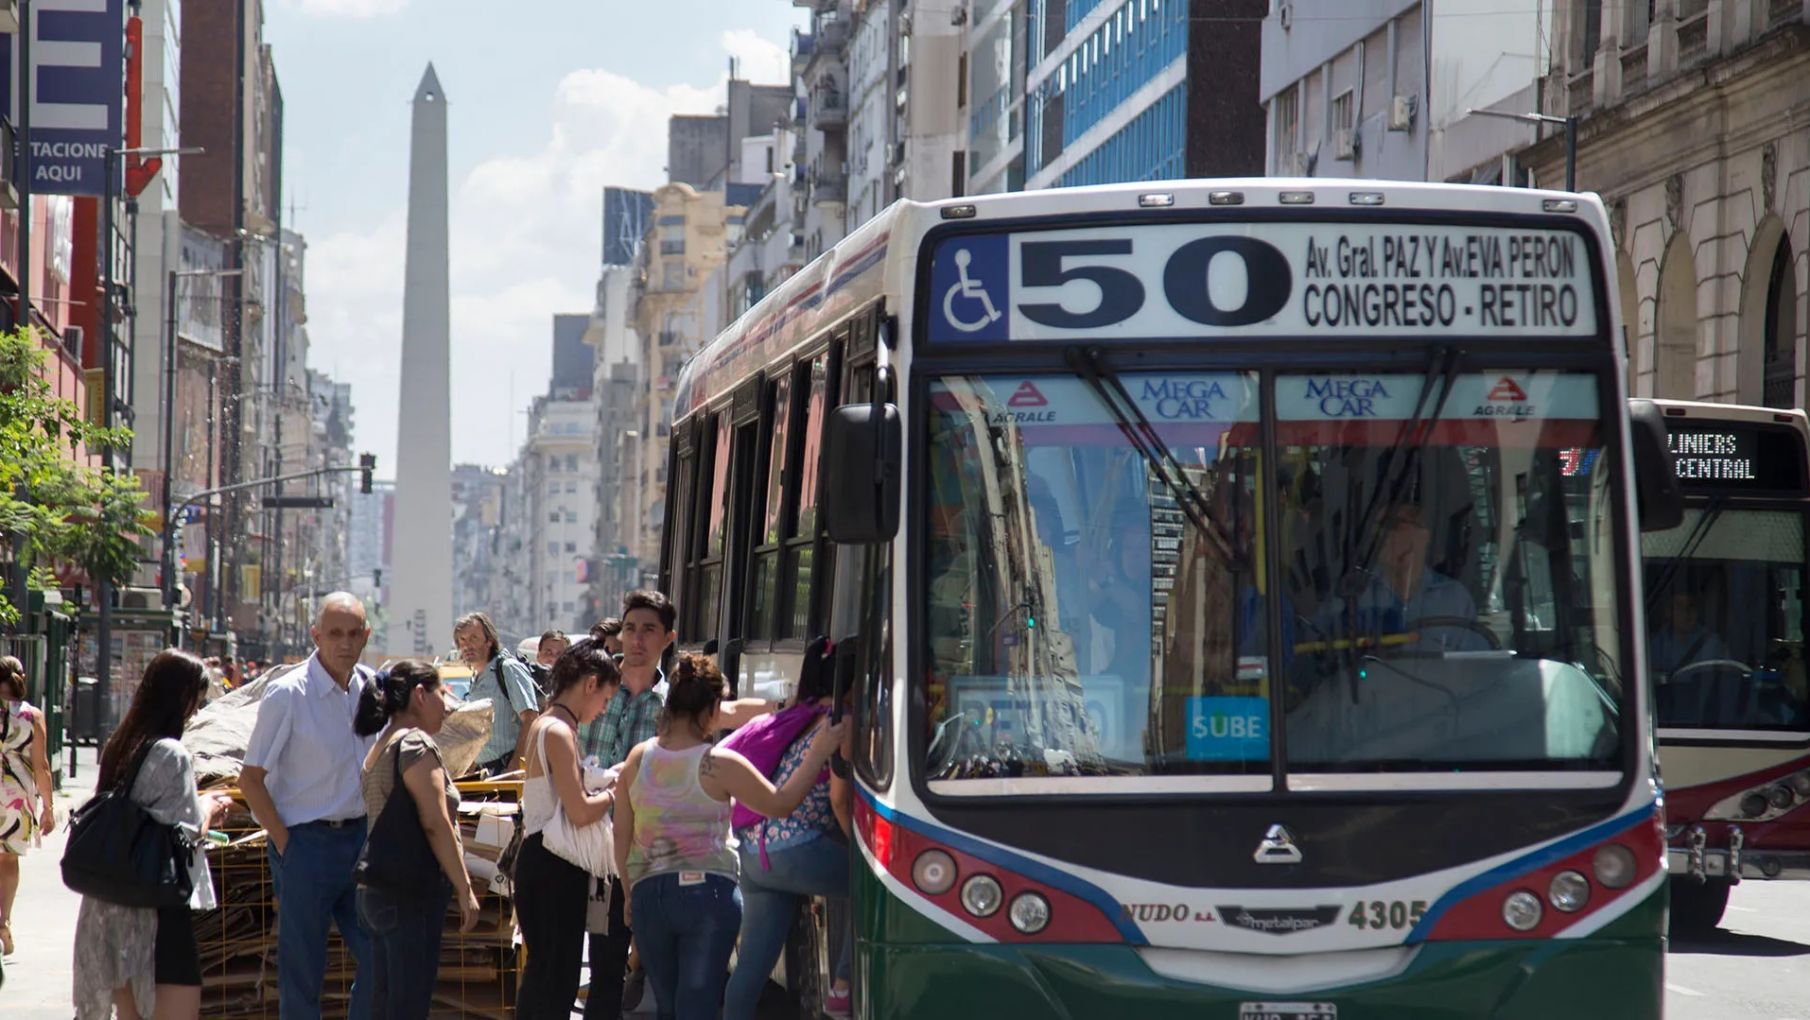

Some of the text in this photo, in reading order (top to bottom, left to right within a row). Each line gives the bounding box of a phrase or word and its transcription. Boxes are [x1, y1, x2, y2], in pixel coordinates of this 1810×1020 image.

[36, 165, 81, 182] AQUI
[1305, 235, 1331, 278] Av.
[1337, 235, 1378, 278] Gral.
[1384, 235, 1420, 278] PAZ
[1426, 235, 1438, 278] Y
[1509, 236, 1575, 279] PERON
[1017, 235, 1293, 329] 50
[1304, 283, 1456, 328] CONGRESO
[1480, 283, 1578, 328] RETIRO
[1141, 379, 1229, 401] MEGA
[1304, 377, 1392, 399] MEGA
[993, 411, 1056, 423] AGRALE
[1156, 398, 1215, 420] CAR
[1319, 397, 1378, 417] CAR
[1473, 405, 1536, 417] AGRALE
[1667, 433, 1736, 454] LINIERS
[1675, 458, 1755, 479] CENTRAL
[1192, 714, 1261, 738] SUBE
[1348, 900, 1427, 930] 4305
